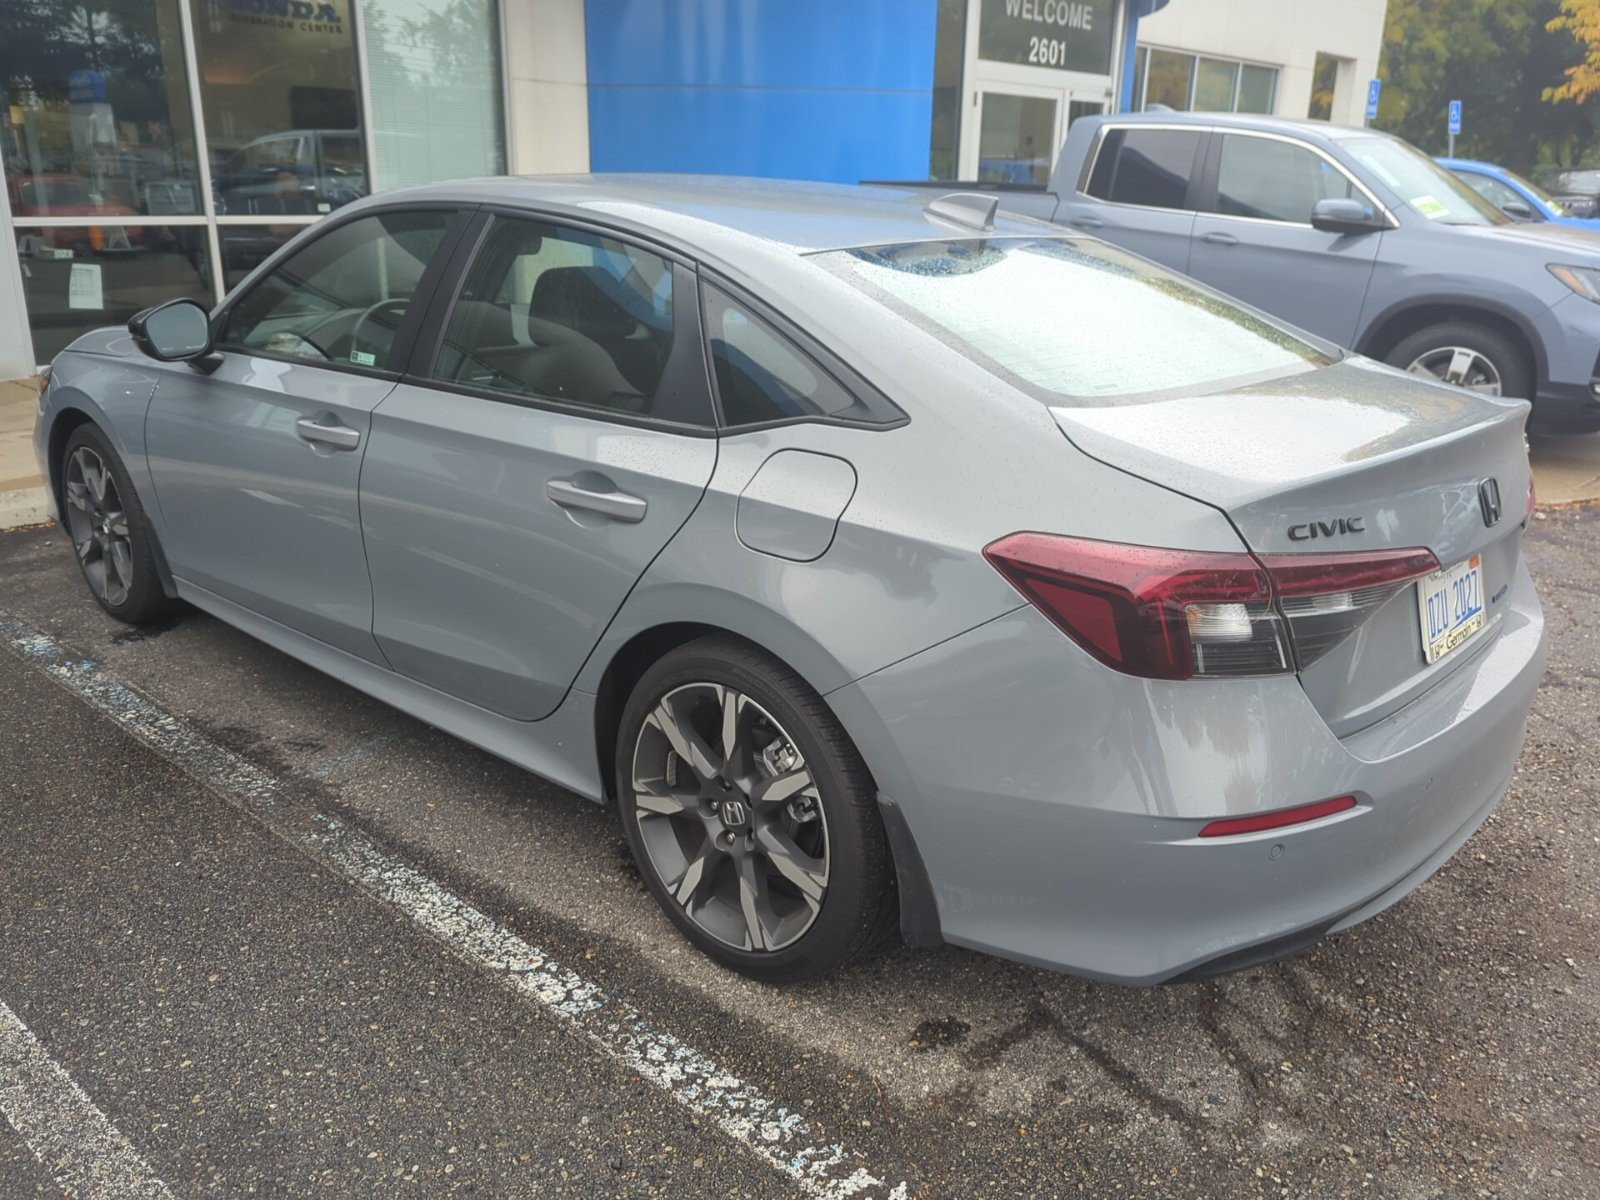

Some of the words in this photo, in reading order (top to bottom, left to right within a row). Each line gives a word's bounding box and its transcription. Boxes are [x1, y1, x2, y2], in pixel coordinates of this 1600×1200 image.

[300, 22, 343, 34] CENTER
[1005, 0, 1093, 30] WELCOME
[1029, 36, 1066, 66] 2601
[1288, 516, 1365, 541] CIVIC
[1453, 569, 1478, 620] 2027
